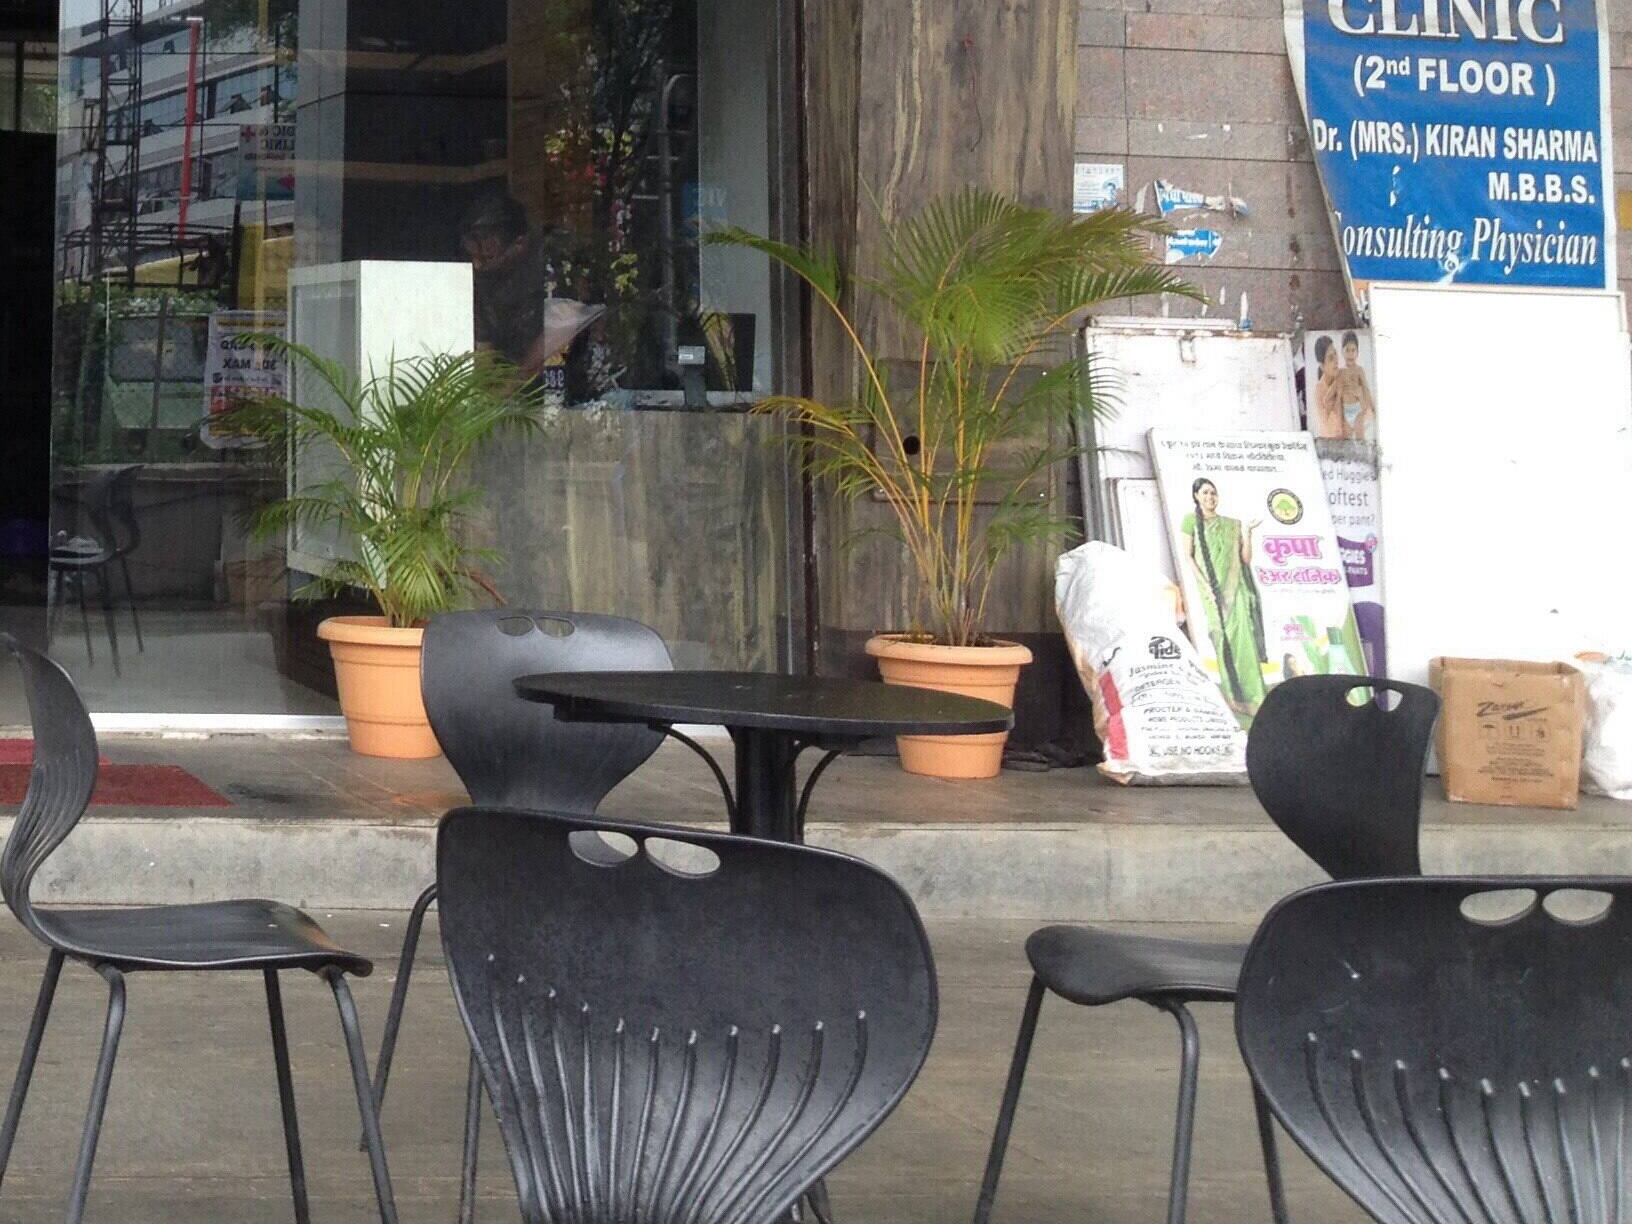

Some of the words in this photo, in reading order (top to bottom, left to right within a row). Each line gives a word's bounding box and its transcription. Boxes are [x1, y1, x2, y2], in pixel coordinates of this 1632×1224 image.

[1353, 54, 1411, 97] (2nd
[1418, 58, 1535, 96] FLOOR
[1312, 119, 1343, 152] Dr.
[1350, 120, 1419, 163] (MRS.)
[1426, 123, 1496, 158] KIRAN
[1503, 126, 1598, 163] SHARMA
[1488, 171, 1596, 204] M.B.B.S.
[1335, 213, 1464, 262] onsulting
[1471, 216, 1598, 275] Physician
[1328, 488, 1369, 506] oftest
[1149, 636, 1181, 660] Tide
